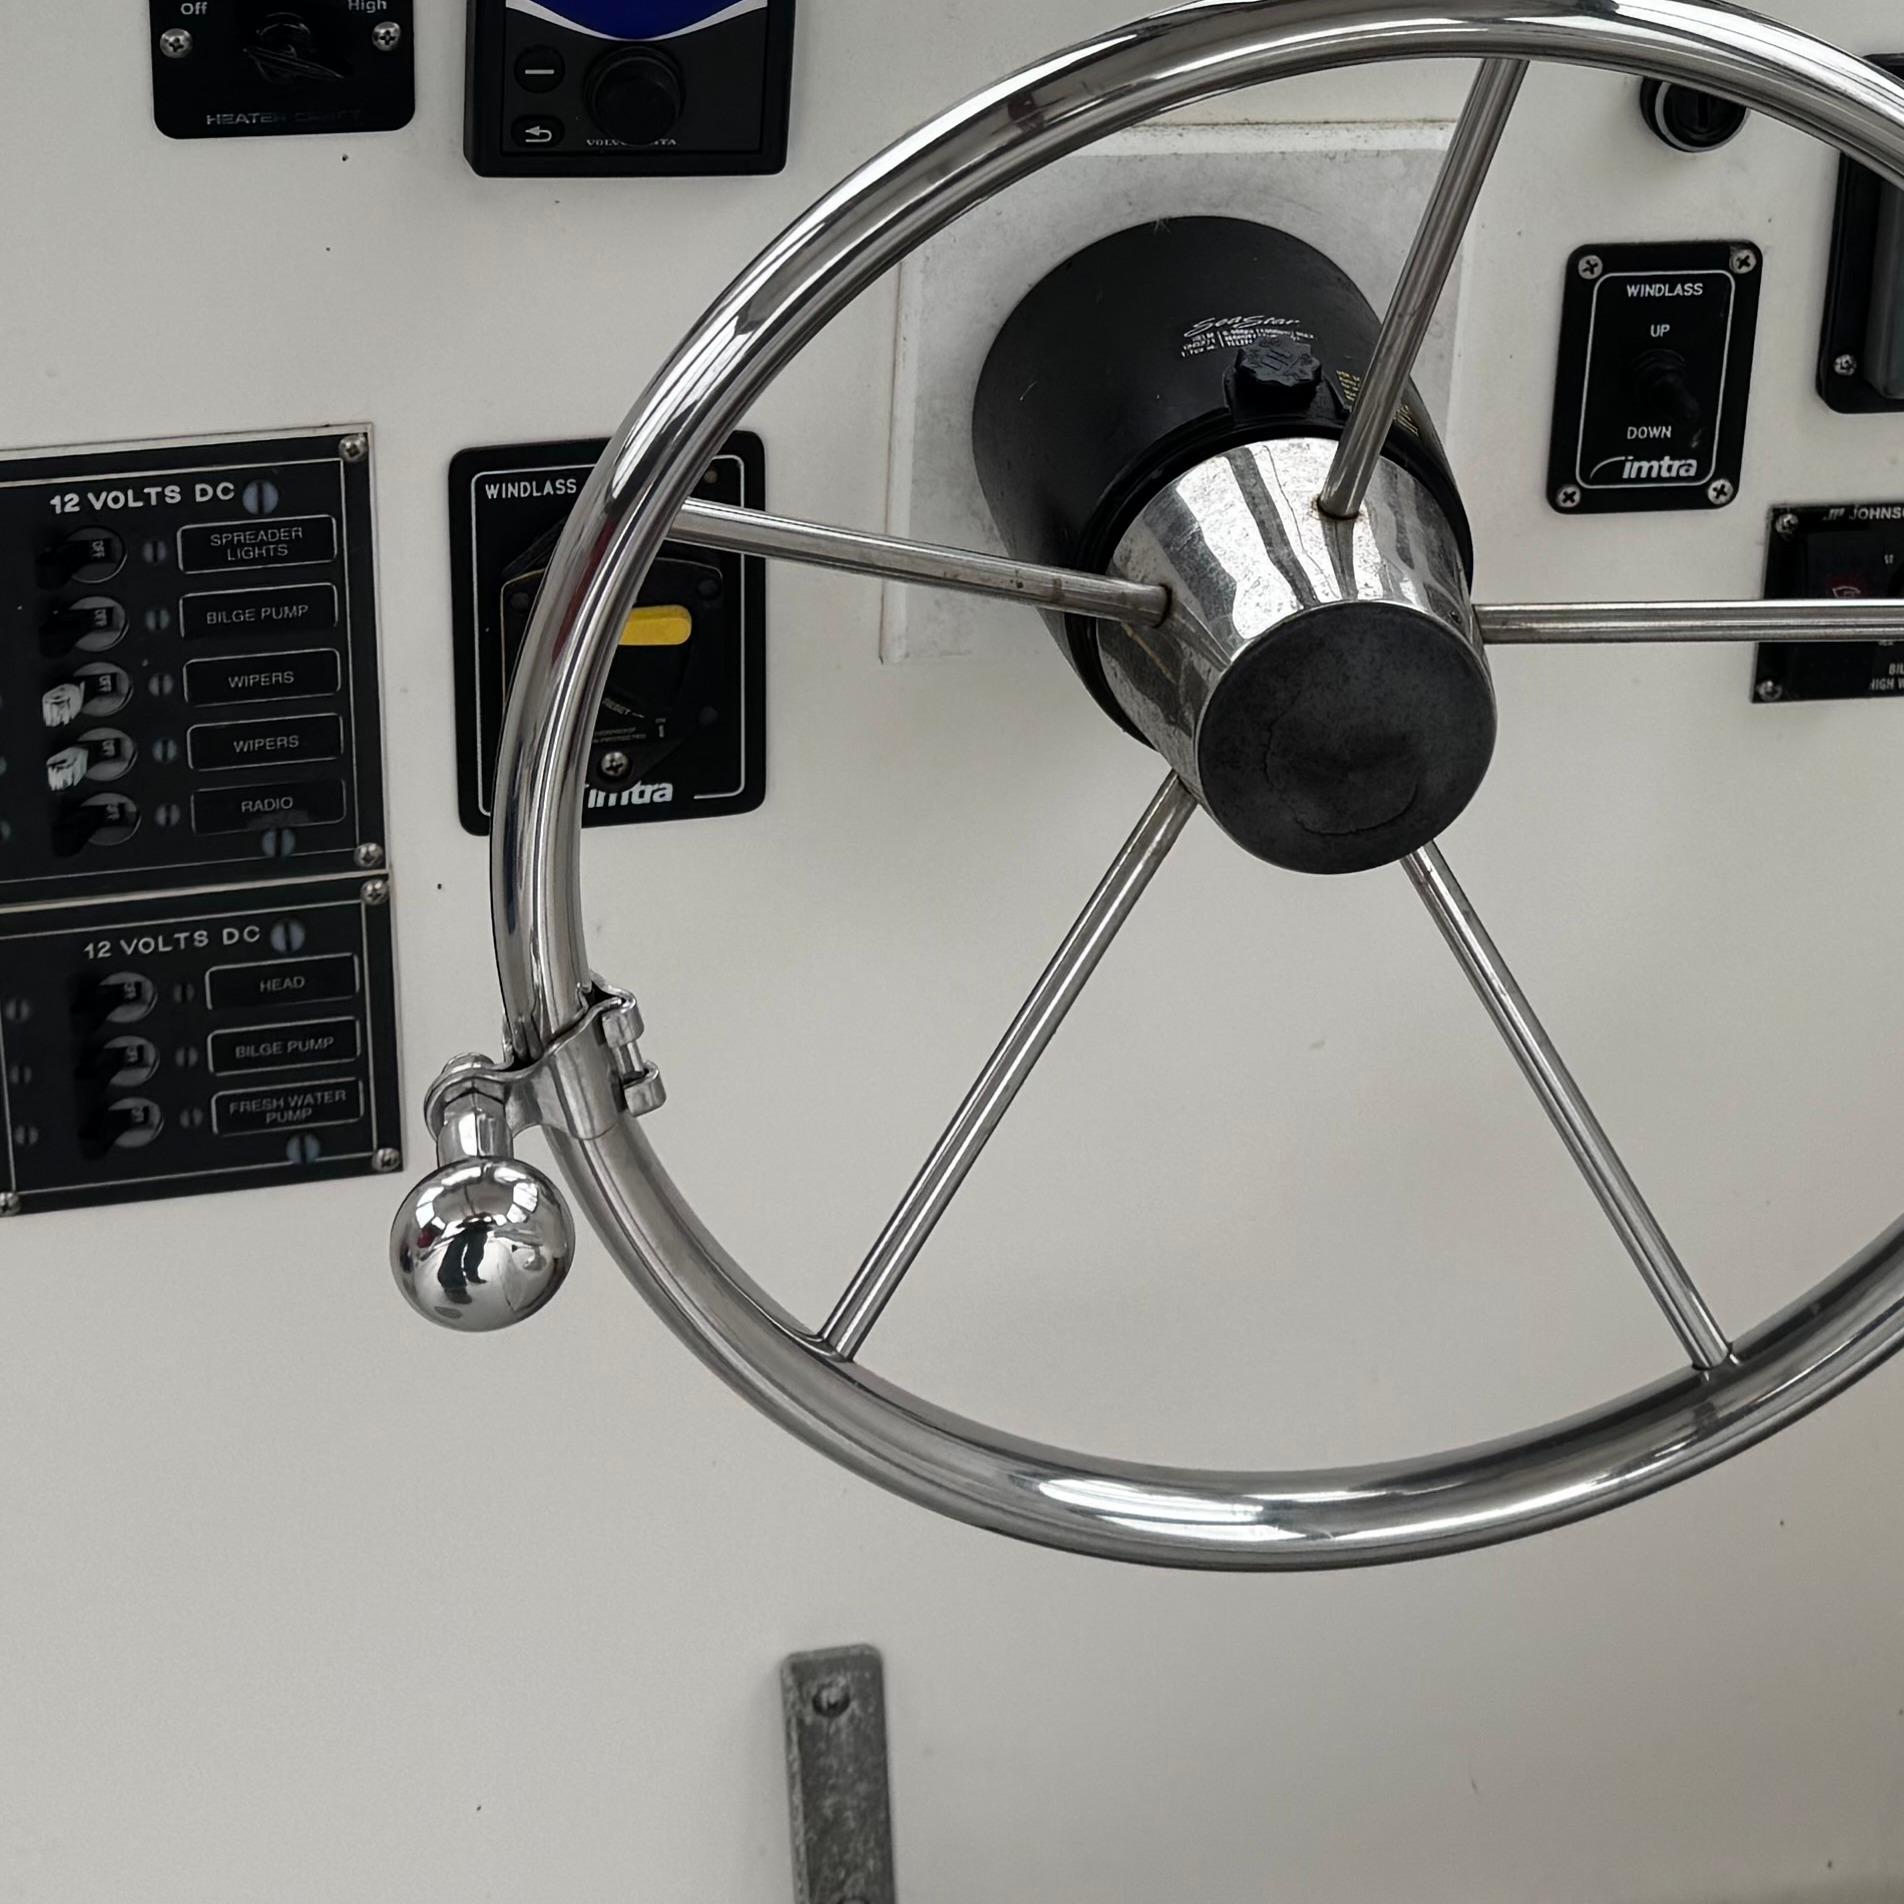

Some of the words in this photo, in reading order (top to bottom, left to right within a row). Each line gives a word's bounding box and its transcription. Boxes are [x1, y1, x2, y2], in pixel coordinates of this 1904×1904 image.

[179, 1, 209, 16] Off
[585, 138, 627, 147] VOLV
[1626, 282, 1703, 298] WINDLASS
[1650, 323, 1671, 339] UP
[1626, 425, 1672, 441] DOWN
[1622, 455, 1698, 479] imtra
[49, 492, 81, 514] 12
[87, 485, 182, 511] VOLTS
[194, 481, 235, 503] DC
[485, 478, 578, 500] WINDLASS
[209, 526, 304, 546] SPREADER
[226, 542, 290, 561] LIGHTS
[206, 608, 256, 625] BILGE
[260, 604, 309, 621] PUMP
[228, 670, 296, 688] WIPERS
[1870, 677, 1895, 691] HIGH
[233, 734, 300, 753] WIPERS
[241, 796, 295, 813] RADIO
[83, 940, 112, 960] 12
[119, 930, 210, 955] VOLTS
[222, 925, 261, 945] DC
[259, 975, 306, 993] HEAD
[234, 1040, 283, 1059] BILGE
[287, 1036, 335, 1053] PUMP
[229, 1096, 288, 1115] FRESH
[286, 1089, 347, 1108] WATER
[265, 1107, 313, 1124] PUMP
